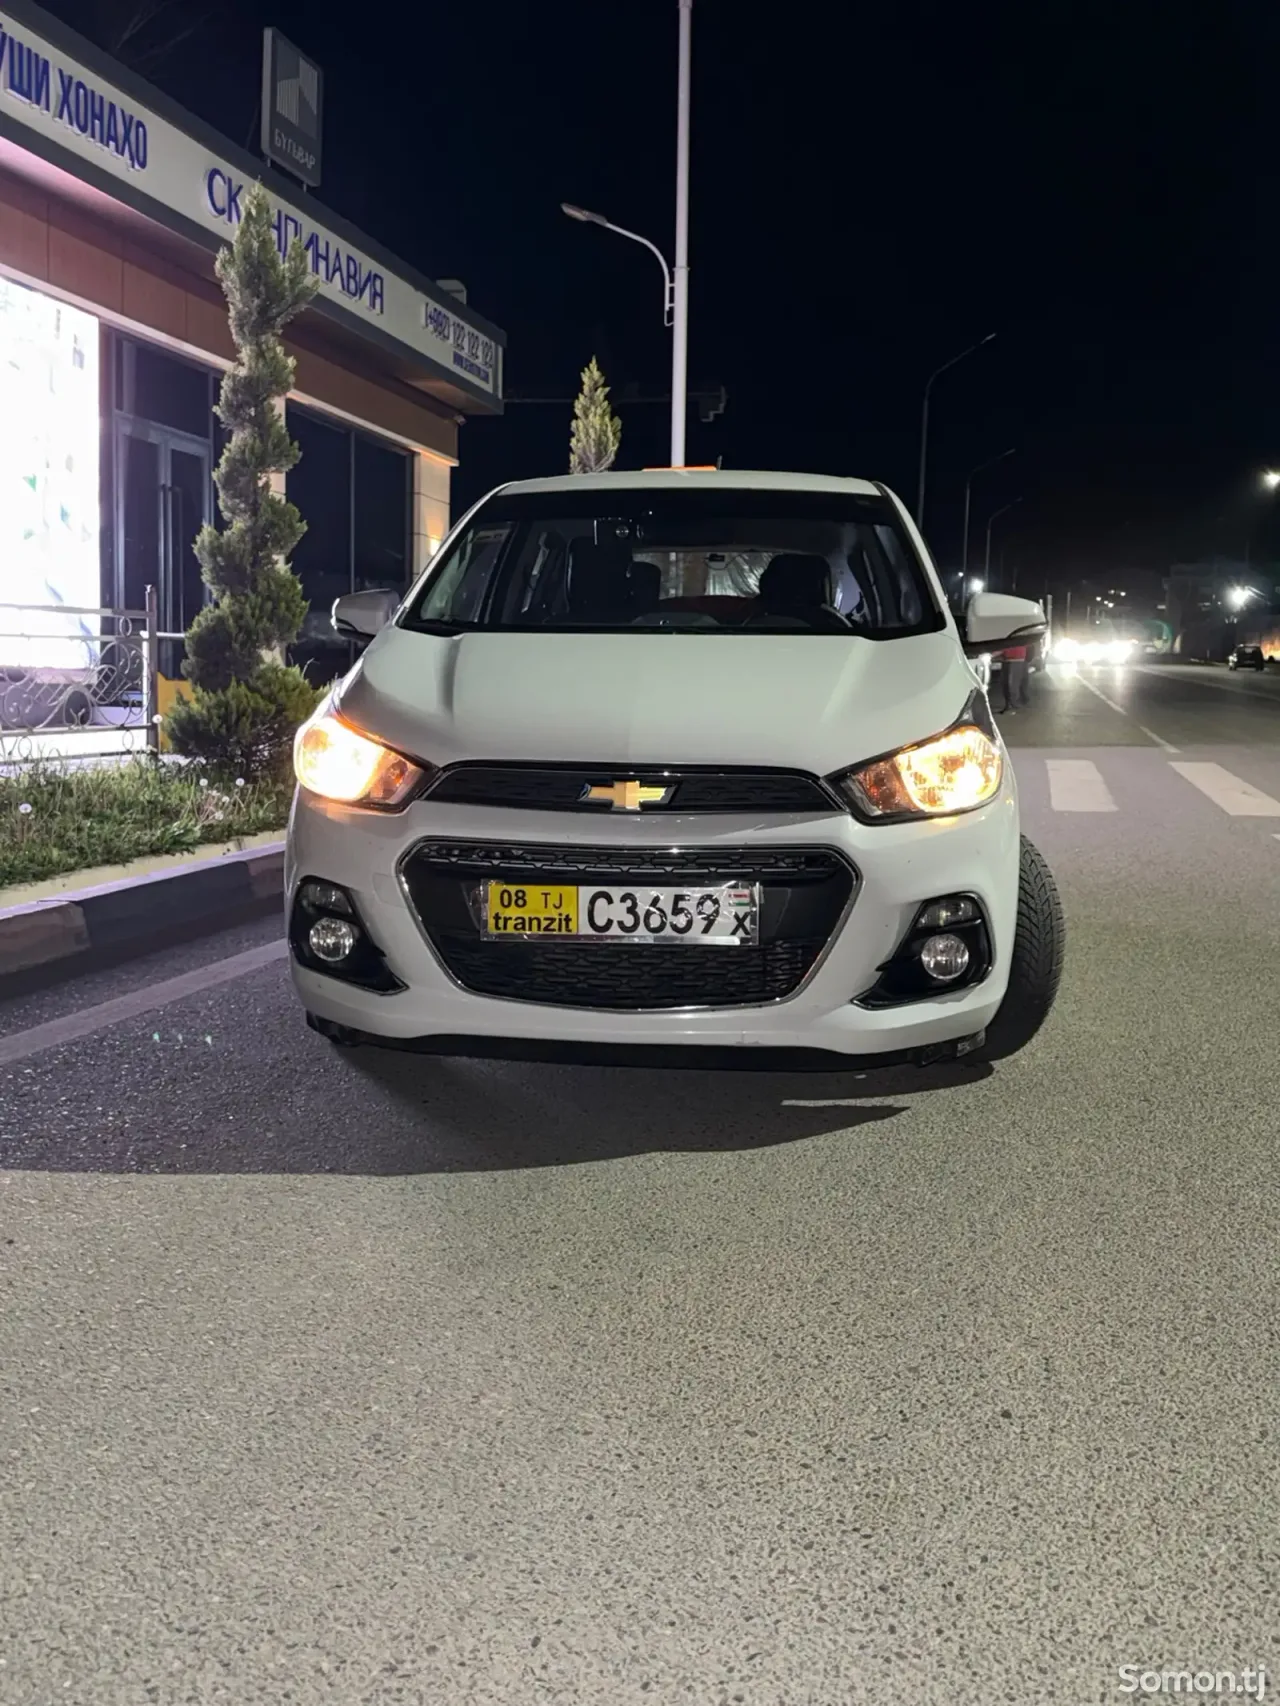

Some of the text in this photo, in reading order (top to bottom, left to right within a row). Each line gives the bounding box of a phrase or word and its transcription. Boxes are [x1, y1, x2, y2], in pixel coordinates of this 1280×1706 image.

[207, 167, 385, 315] СКНДИНАВИЯ
[452, 320, 466, 350] 122
[467, 330, 480, 360] 122
[500, 889, 563, 910] 08 TJ
[587, 890, 721, 935] C3659
[493, 912, 573, 933] tranzit
